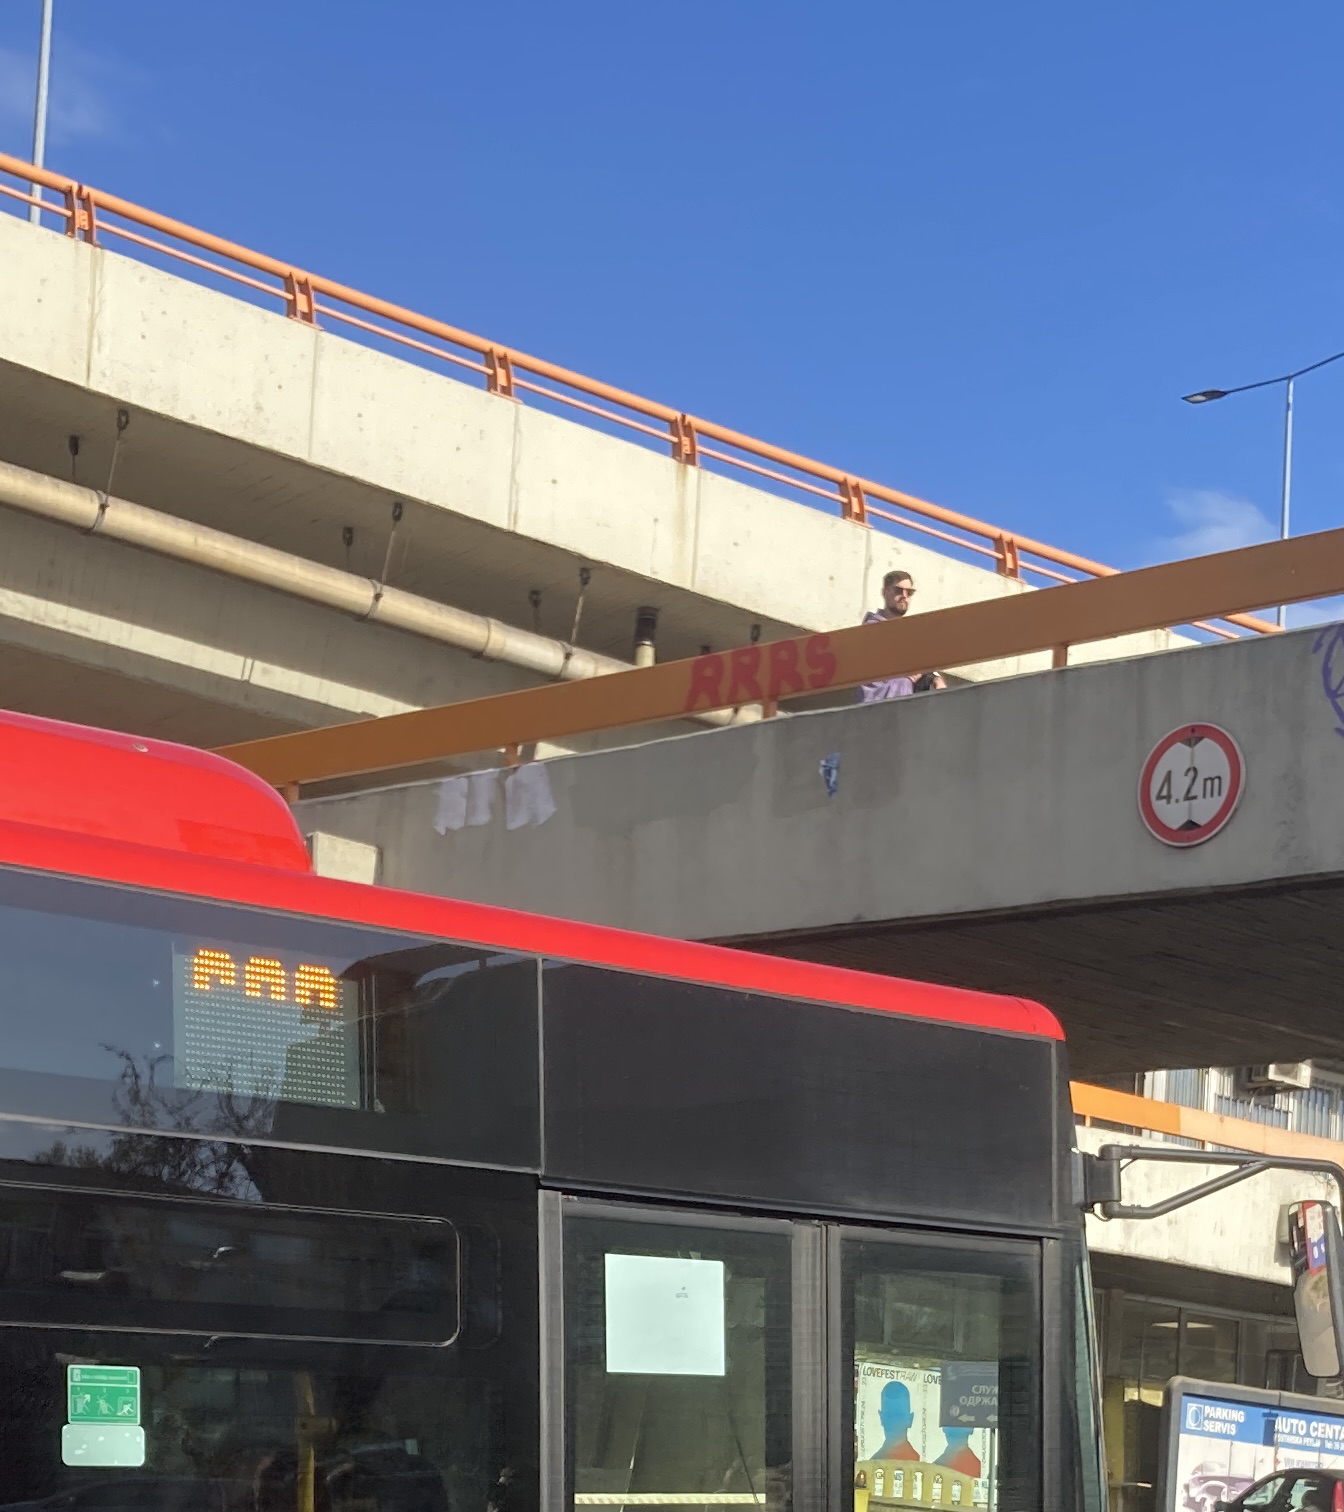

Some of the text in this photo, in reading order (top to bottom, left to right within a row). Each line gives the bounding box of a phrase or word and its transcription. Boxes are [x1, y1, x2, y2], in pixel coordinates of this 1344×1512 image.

[1204, 1405, 1245, 1422] PARKING
[1203, 1419, 1236, 1435] SERVIS
[1274, 1416, 1308, 1436] AUTO
